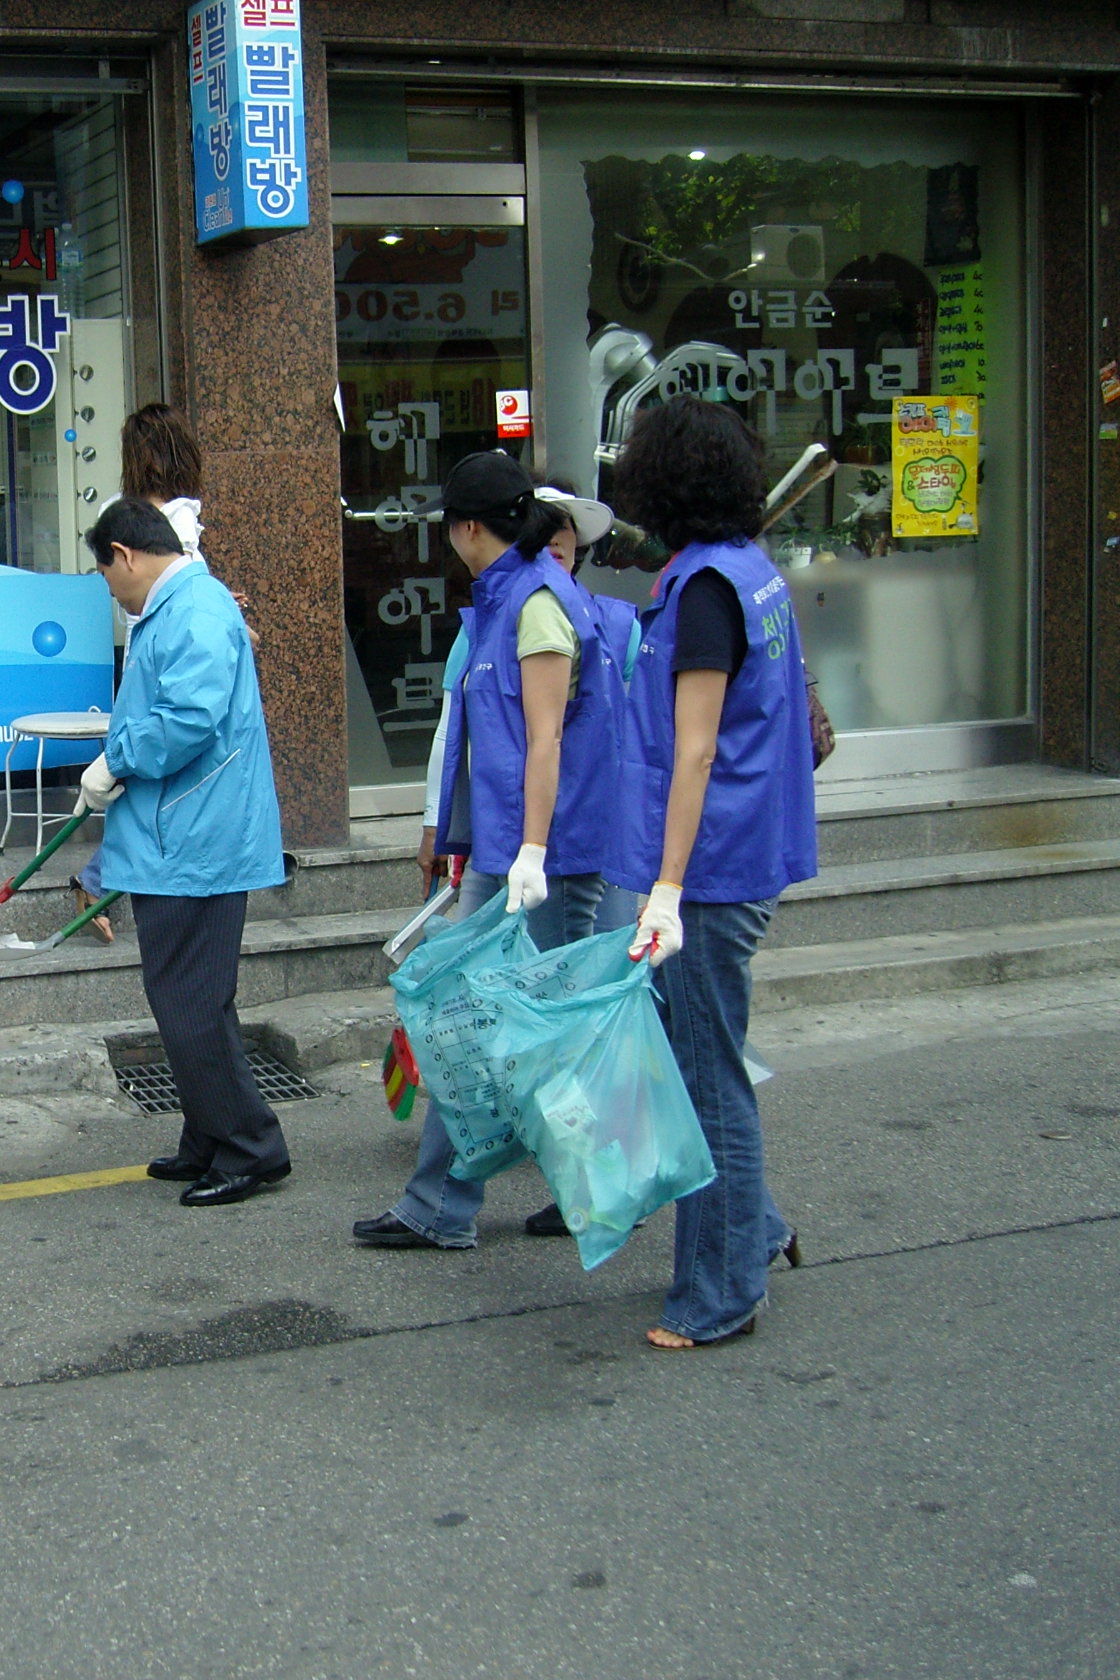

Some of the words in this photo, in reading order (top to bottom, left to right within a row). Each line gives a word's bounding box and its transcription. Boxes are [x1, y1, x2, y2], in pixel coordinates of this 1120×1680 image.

[191, 13, 204, 86] 셀프
[204, 1, 232, 182] 빨래방
[243, 41, 302, 219] 빨래방
[728, 289, 835, 329] 안금순
